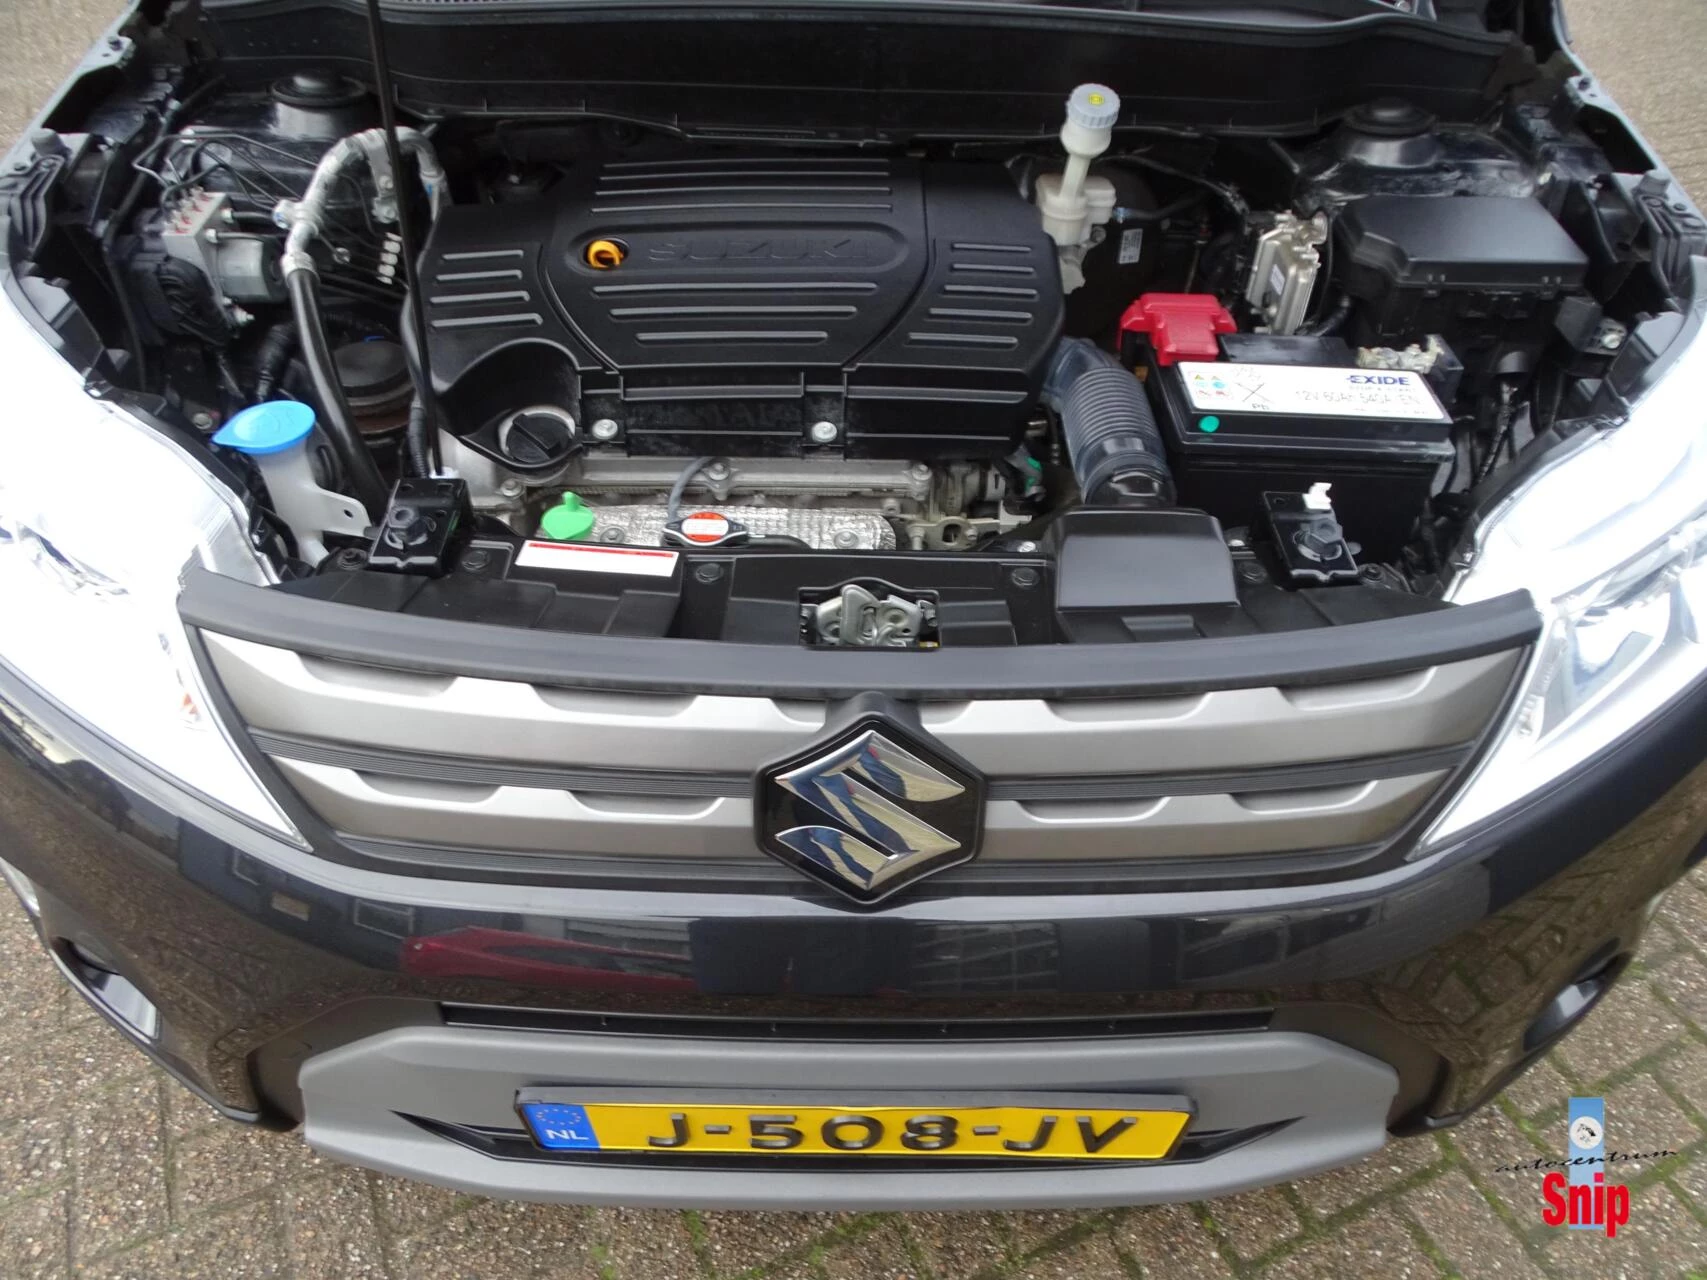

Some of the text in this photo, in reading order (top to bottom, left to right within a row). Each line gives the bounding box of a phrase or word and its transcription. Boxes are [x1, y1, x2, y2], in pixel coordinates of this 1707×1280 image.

[1346, 375, 1410, 386] EXIDE
[545, 1129, 589, 1140] NL
[648, 1113, 1138, 1153] J-508-JV
